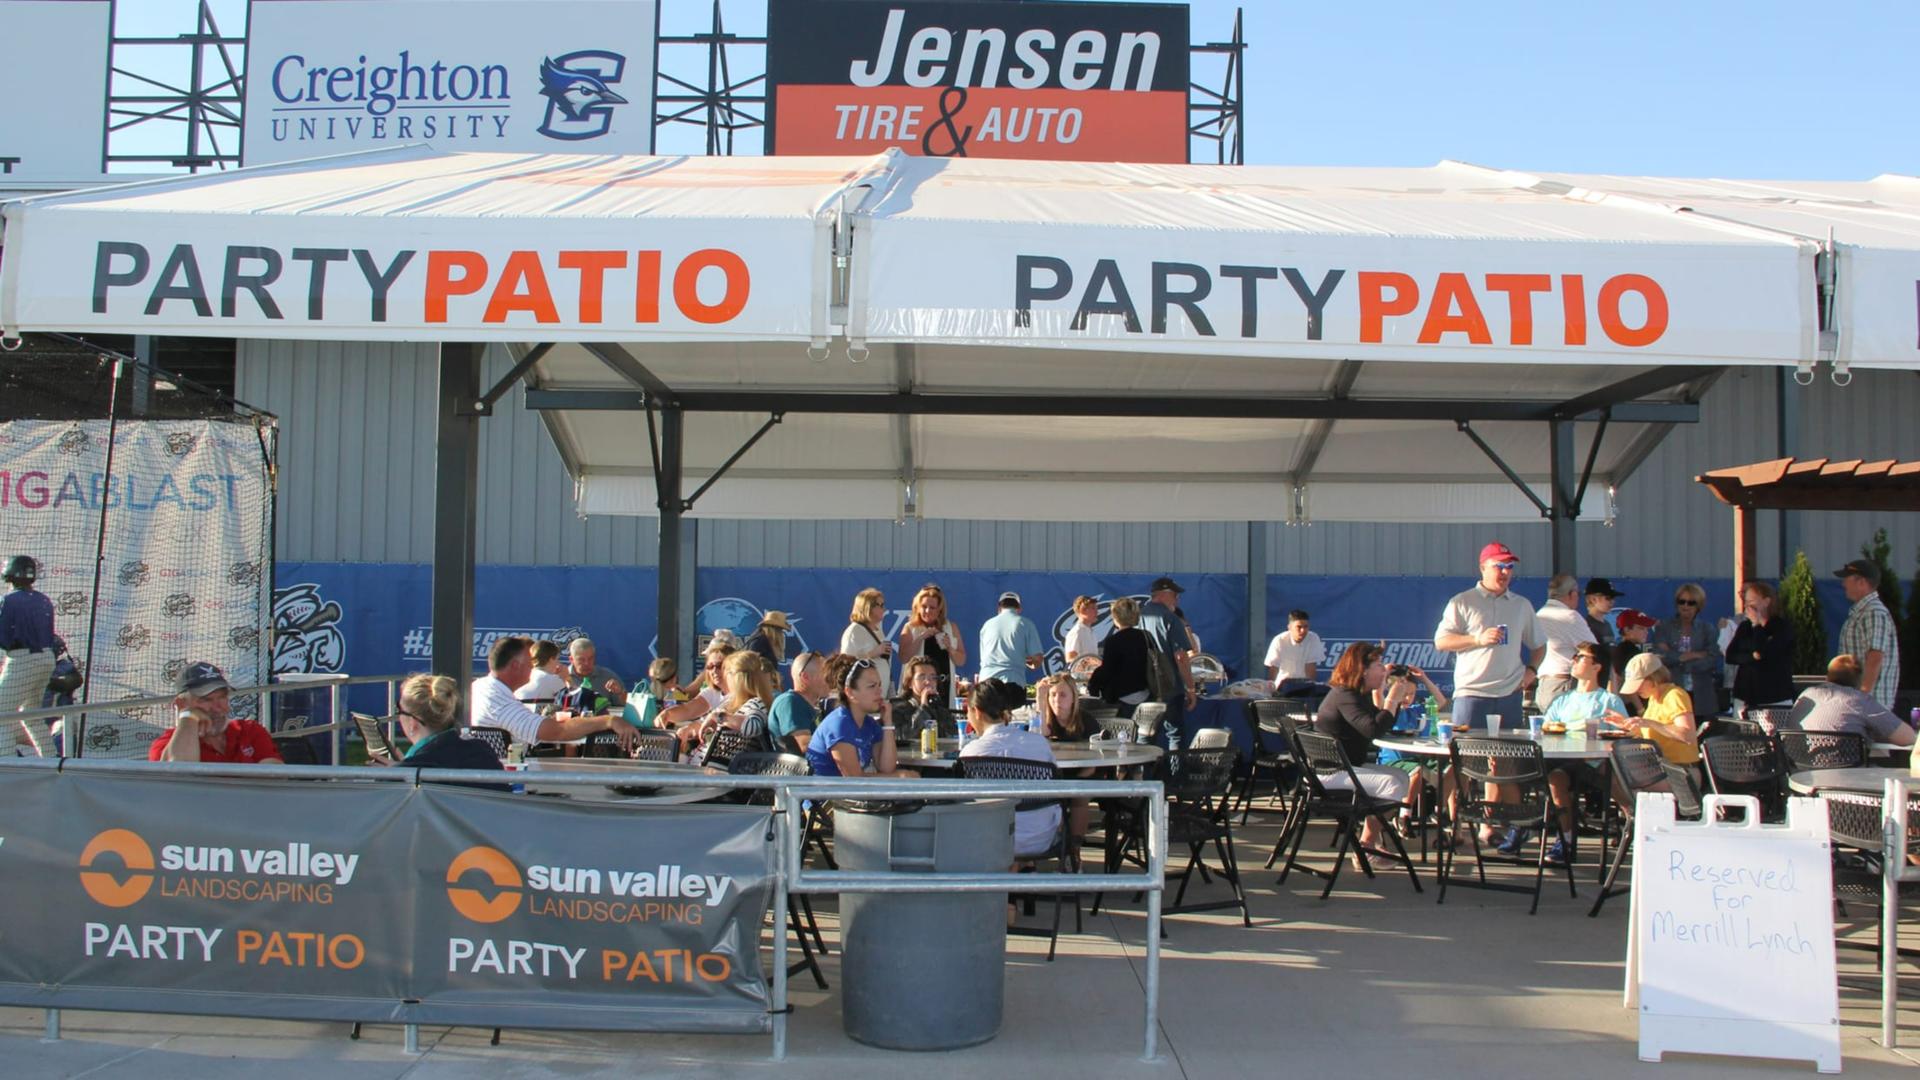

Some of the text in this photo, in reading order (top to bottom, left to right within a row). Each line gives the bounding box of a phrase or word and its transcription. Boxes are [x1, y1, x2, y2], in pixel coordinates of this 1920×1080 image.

[850, 9, 1161, 92] Jensen
[272, 51, 511, 116] Creighton
[272, 114, 511, 142] UNIVERSITY
[835, 86, 1083, 158] TIRE & AUTO
[161, 842, 359, 885] sun valley
[527, 864, 732, 907] sun valley
[1669, 850, 1801, 893] Reserved
[160, 876, 333, 904] LANDSCAPING
[529, 895, 702, 925] LANDSCAPING
[85, 922, 366, 970] PARTY PATIO
[1652, 911, 1816, 960] Merrill Lynch
[449, 937, 731, 983] PARTY PATIO
